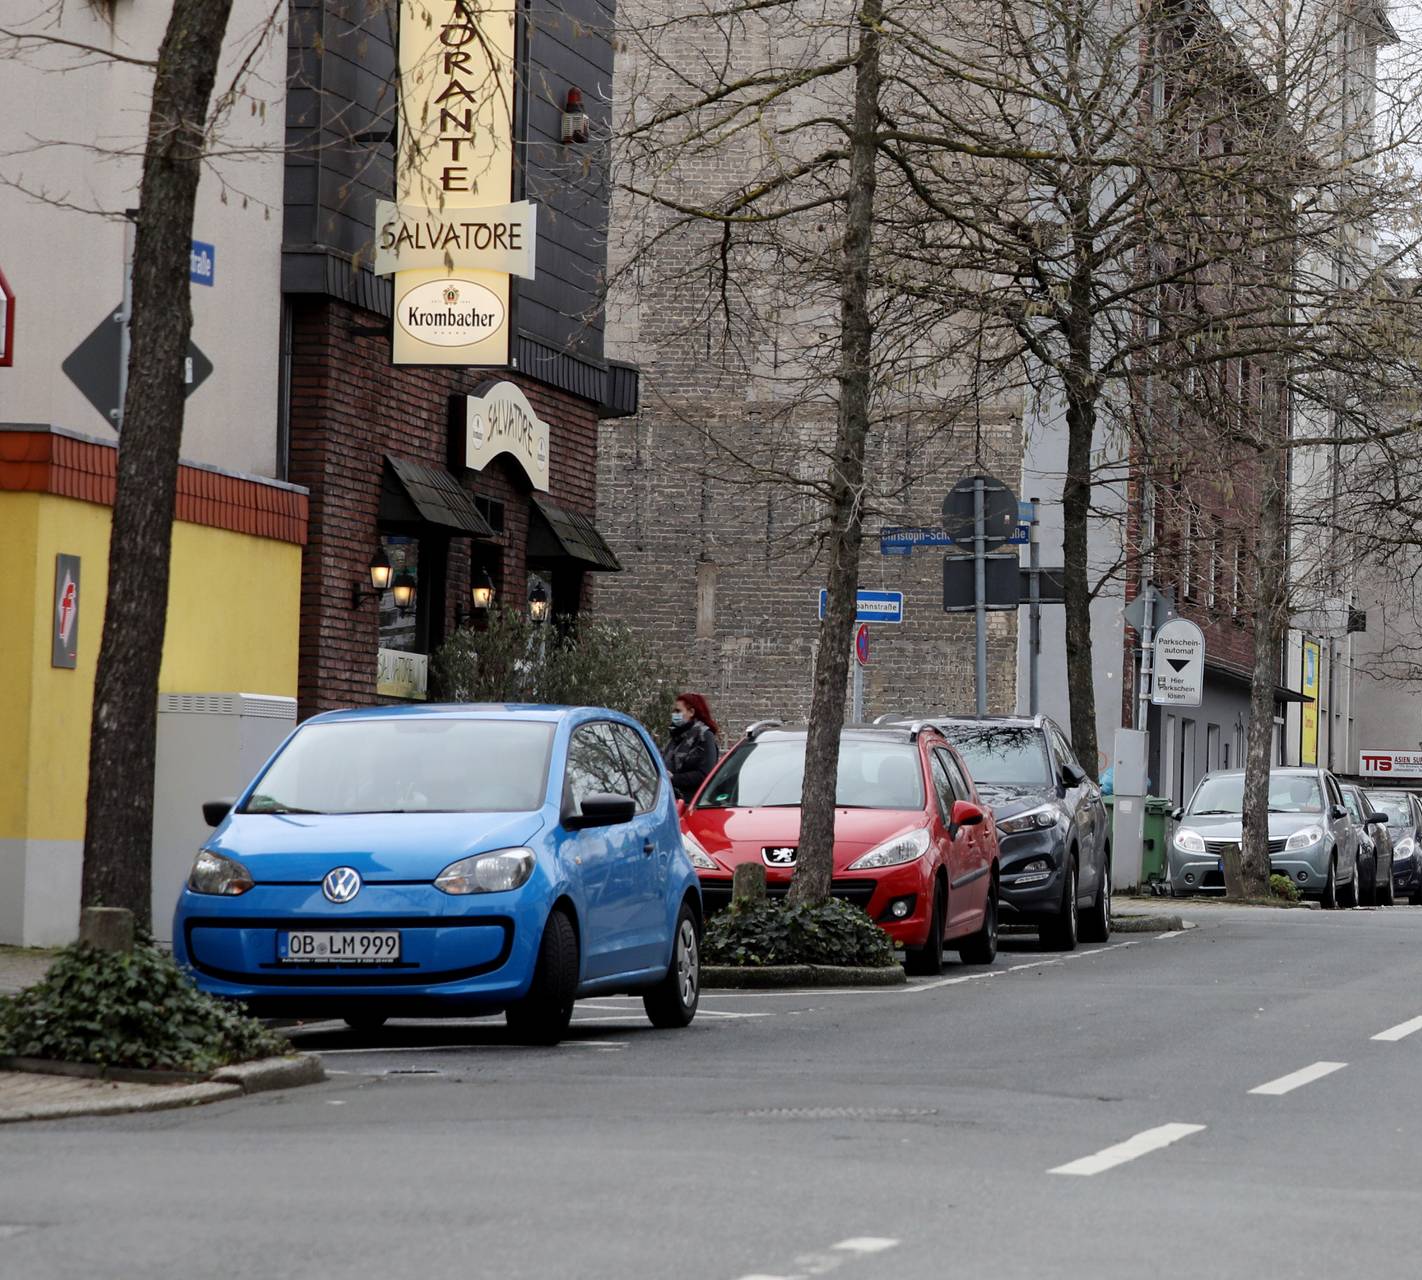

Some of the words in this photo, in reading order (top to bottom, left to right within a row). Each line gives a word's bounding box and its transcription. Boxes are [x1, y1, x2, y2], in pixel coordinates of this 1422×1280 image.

[380, 222, 522, 250] SALVATORE
[408, 306, 495, 327] Krombacher
[487, 399, 534, 458] SALVATORE
[1158, 638, 1201, 647] Parkschein-
[1164, 647, 1194, 655] automat
[1362, 755, 1393, 771] TTS
[1394, 756, 1411, 764] ASIEN
[290, 935, 315, 954] OB
[329, 935, 355, 955] LM
[360, 936, 397, 955] 999
